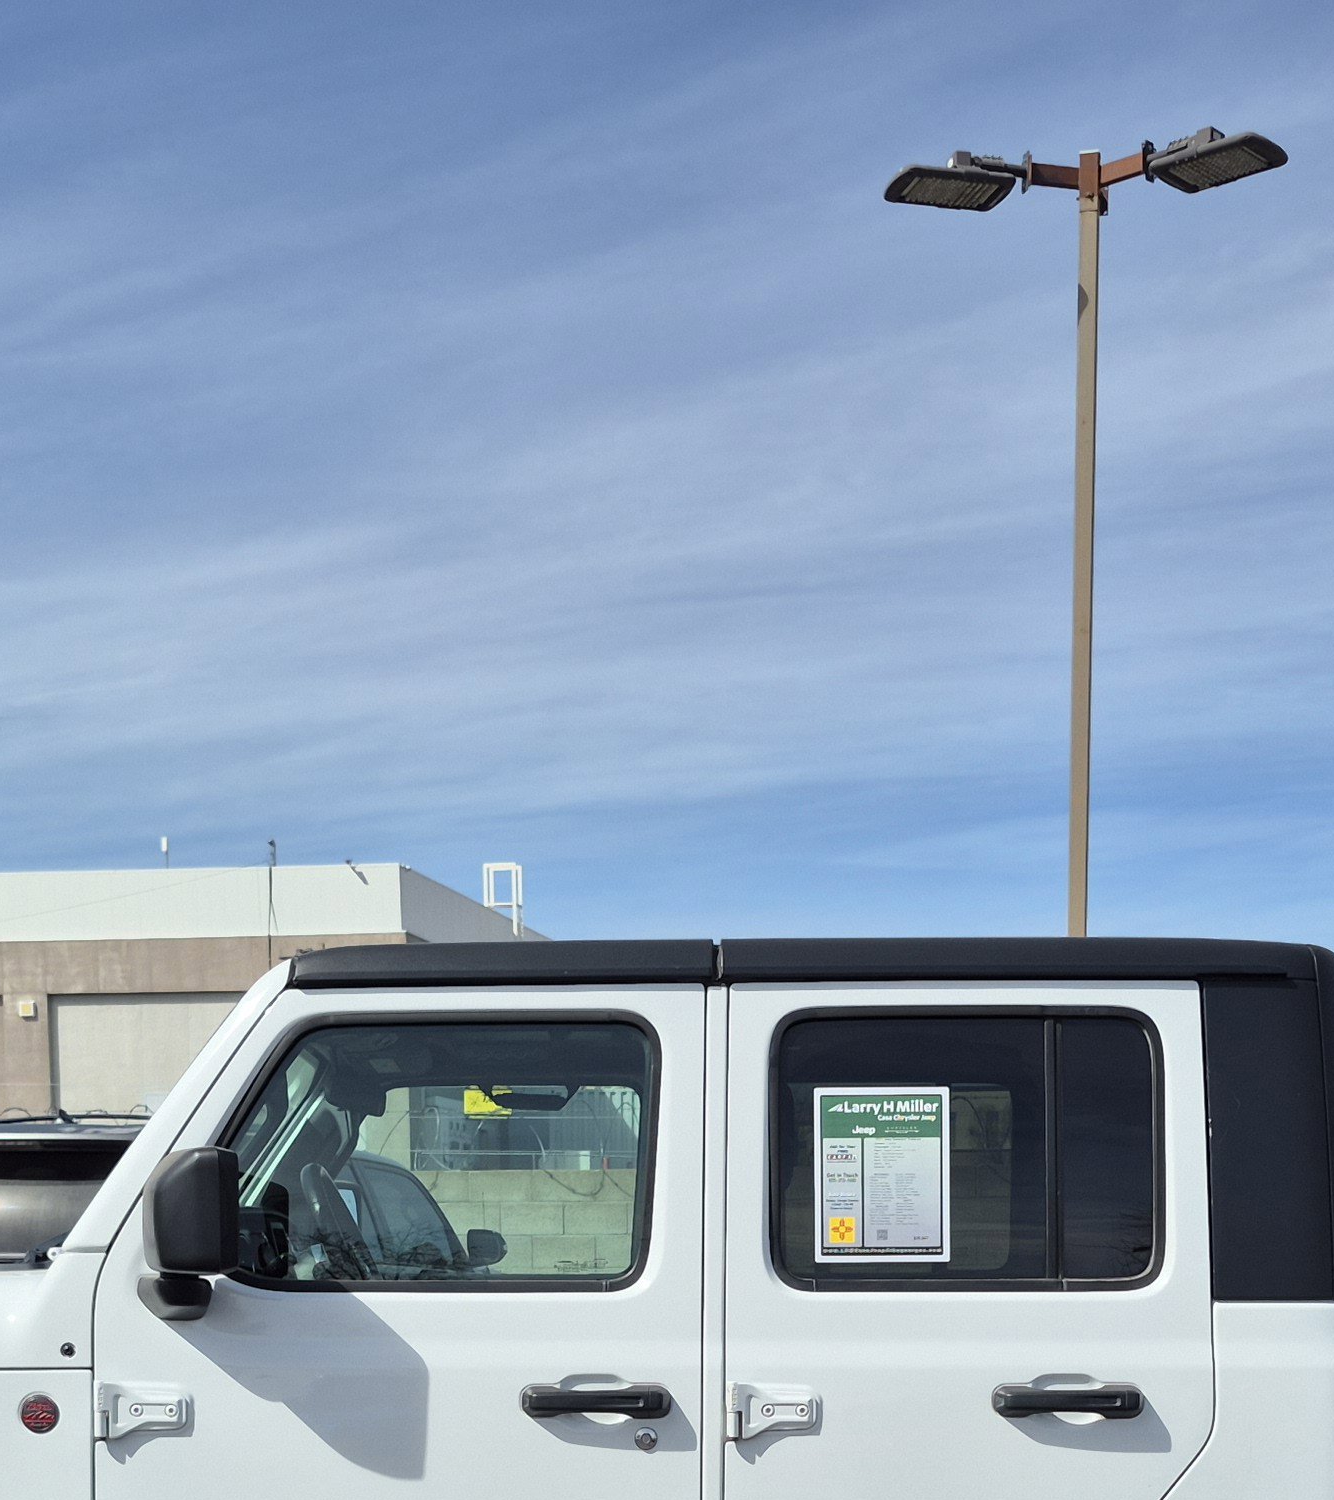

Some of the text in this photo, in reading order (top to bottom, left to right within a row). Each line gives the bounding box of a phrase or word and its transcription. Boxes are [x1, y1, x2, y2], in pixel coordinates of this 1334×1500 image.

[844, 1099, 939, 1115] Larry H Miller
[851, 1125, 876, 1136] Jeep
